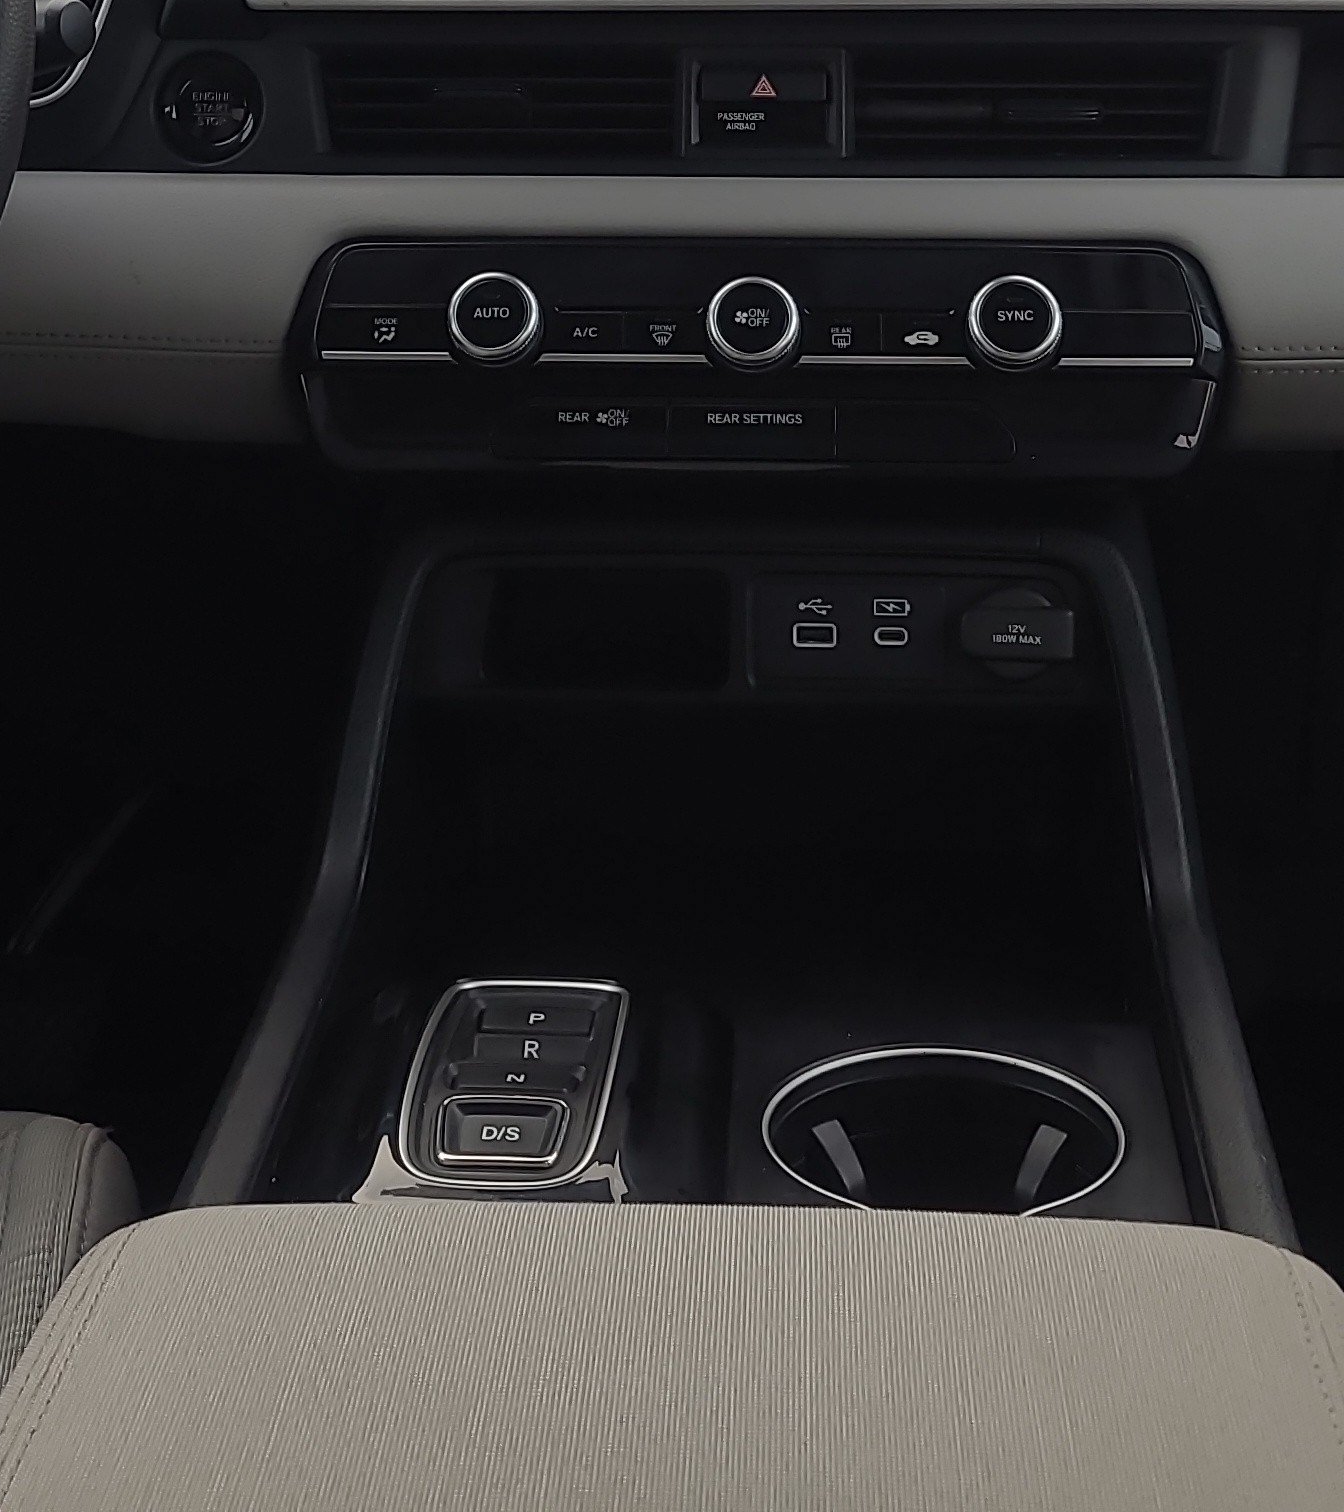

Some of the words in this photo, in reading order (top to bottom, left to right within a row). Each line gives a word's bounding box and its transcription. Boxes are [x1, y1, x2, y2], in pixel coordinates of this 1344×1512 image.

[717, 112, 765, 121] PASSENGER
[473, 307, 510, 319] AUTO
[997, 310, 1034, 322] SYNC
[649, 324, 676, 332] FRONT
[748, 318, 771, 328] OFF
[573, 327, 598, 338] A/C
[558, 411, 590, 423] REAR
[707, 413, 740, 424] REAR
[742, 413, 803, 425] SETTINGS
[608, 418, 630, 428] OFF
[1008, 624, 1027, 634] 12V
[1018, 635, 1042, 645] MAX
[528, 1012, 546, 1025] P
[523, 1039, 540, 1059] R
[505, 1073, 526, 1083] N
[481, 1126, 521, 1141] D/S
